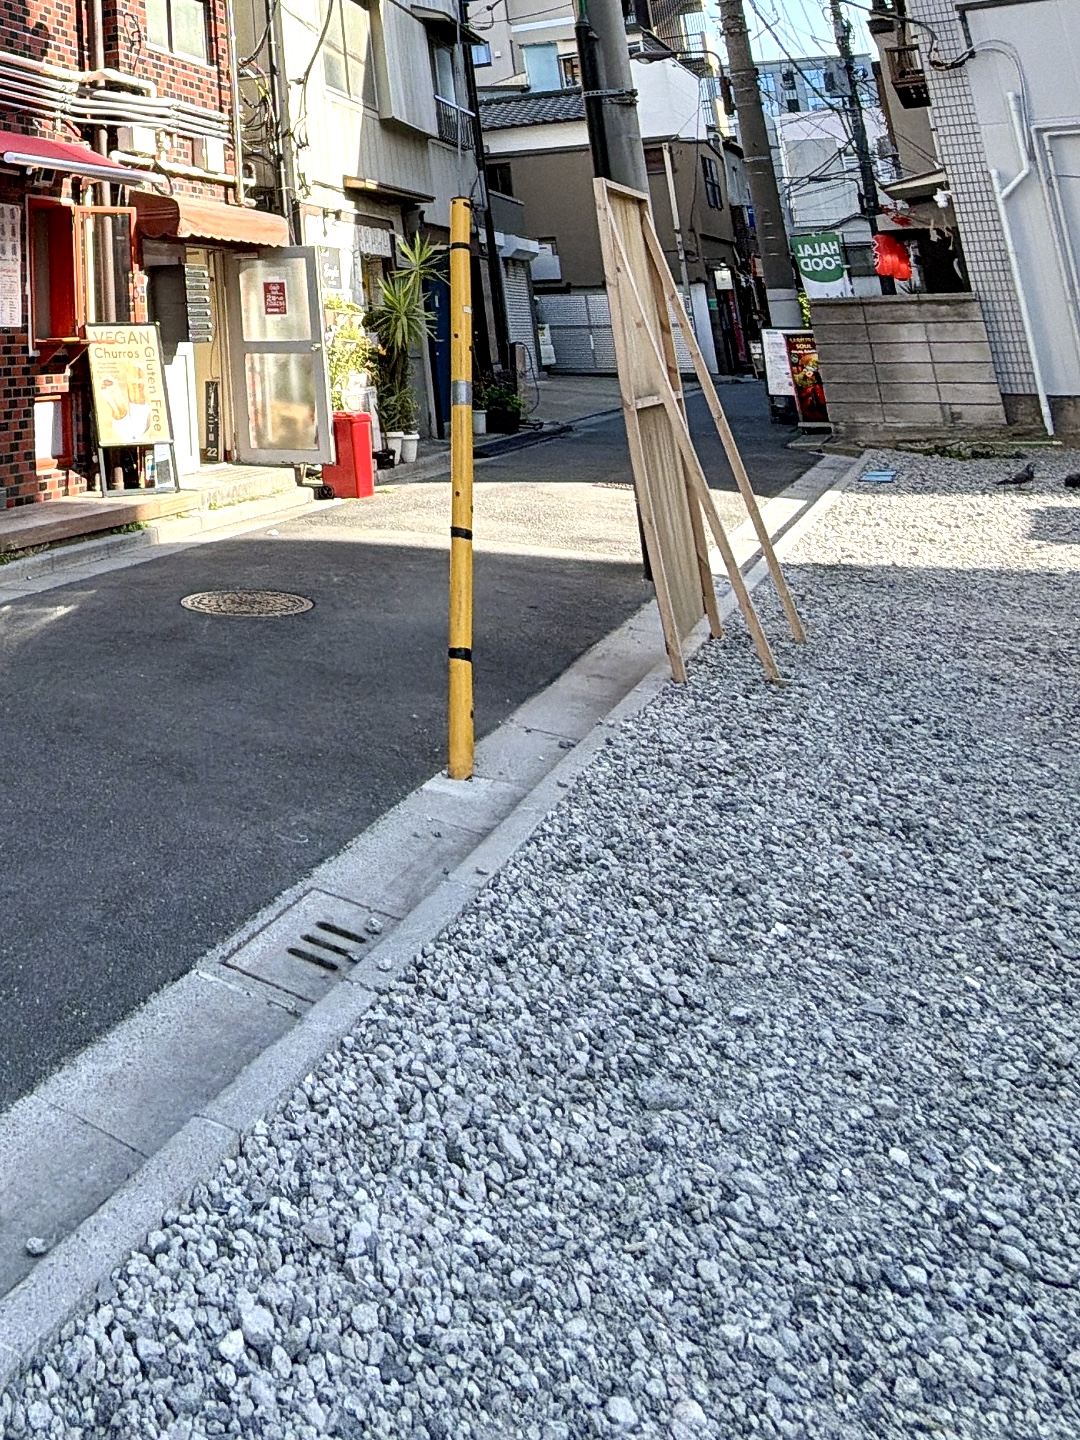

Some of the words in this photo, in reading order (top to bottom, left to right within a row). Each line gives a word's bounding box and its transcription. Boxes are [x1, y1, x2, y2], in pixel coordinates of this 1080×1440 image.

[93, 331, 150, 345] VEGAN
[94, 347, 140, 359] Churros
[144, 346, 157, 395] Gluten
[150, 400, 162, 432] Free
[207, 447, 218, 457] 22
